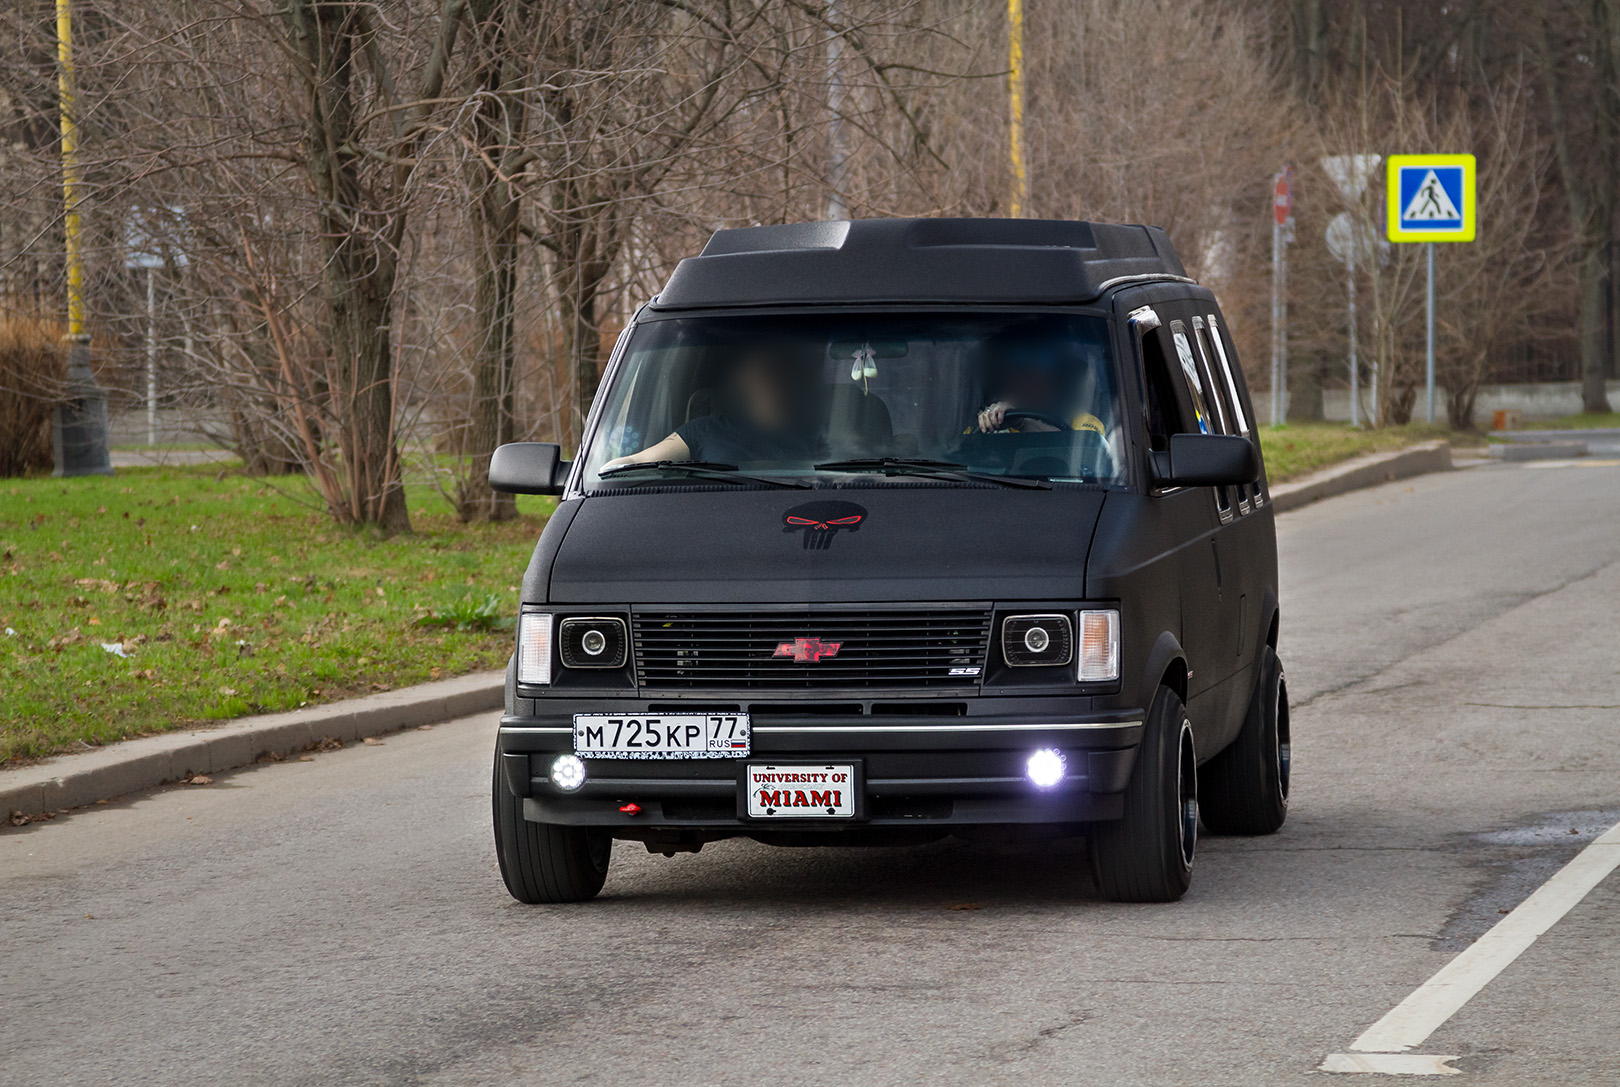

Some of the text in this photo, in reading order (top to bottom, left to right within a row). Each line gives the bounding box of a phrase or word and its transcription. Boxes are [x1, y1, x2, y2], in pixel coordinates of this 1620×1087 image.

[710, 717, 738, 739] 77
[709, 739, 730, 748] RUS
[753, 773, 848, 783] UNIVERSITY OF
[759, 790, 842, 807] MIAMI
